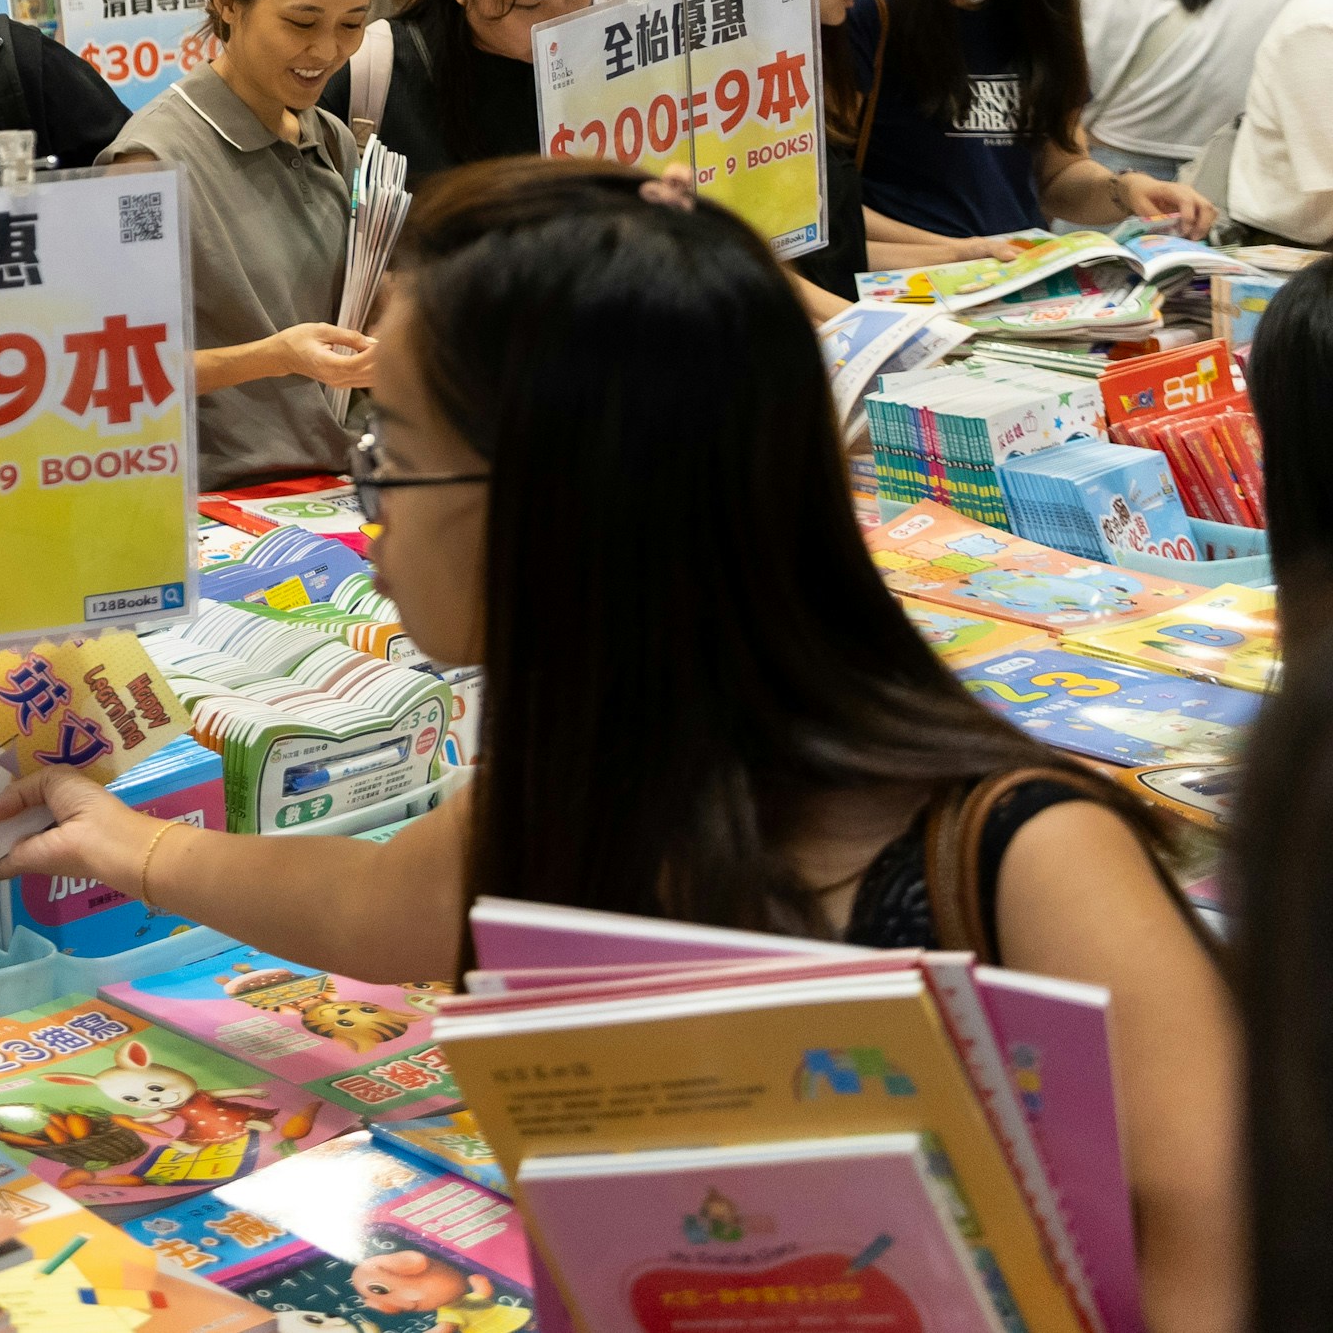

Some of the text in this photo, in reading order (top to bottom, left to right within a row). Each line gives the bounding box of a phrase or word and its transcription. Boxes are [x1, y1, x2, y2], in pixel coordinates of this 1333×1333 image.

[550, 51, 810, 166] $200=9本
[697, 133, 814, 185] or 9 BOOKS)
[41, 444, 179, 487] BOOKS)
[91, 592, 158, 612] 128Books
[83, 664, 149, 750] Learning
[126, 672, 173, 731] Happy
